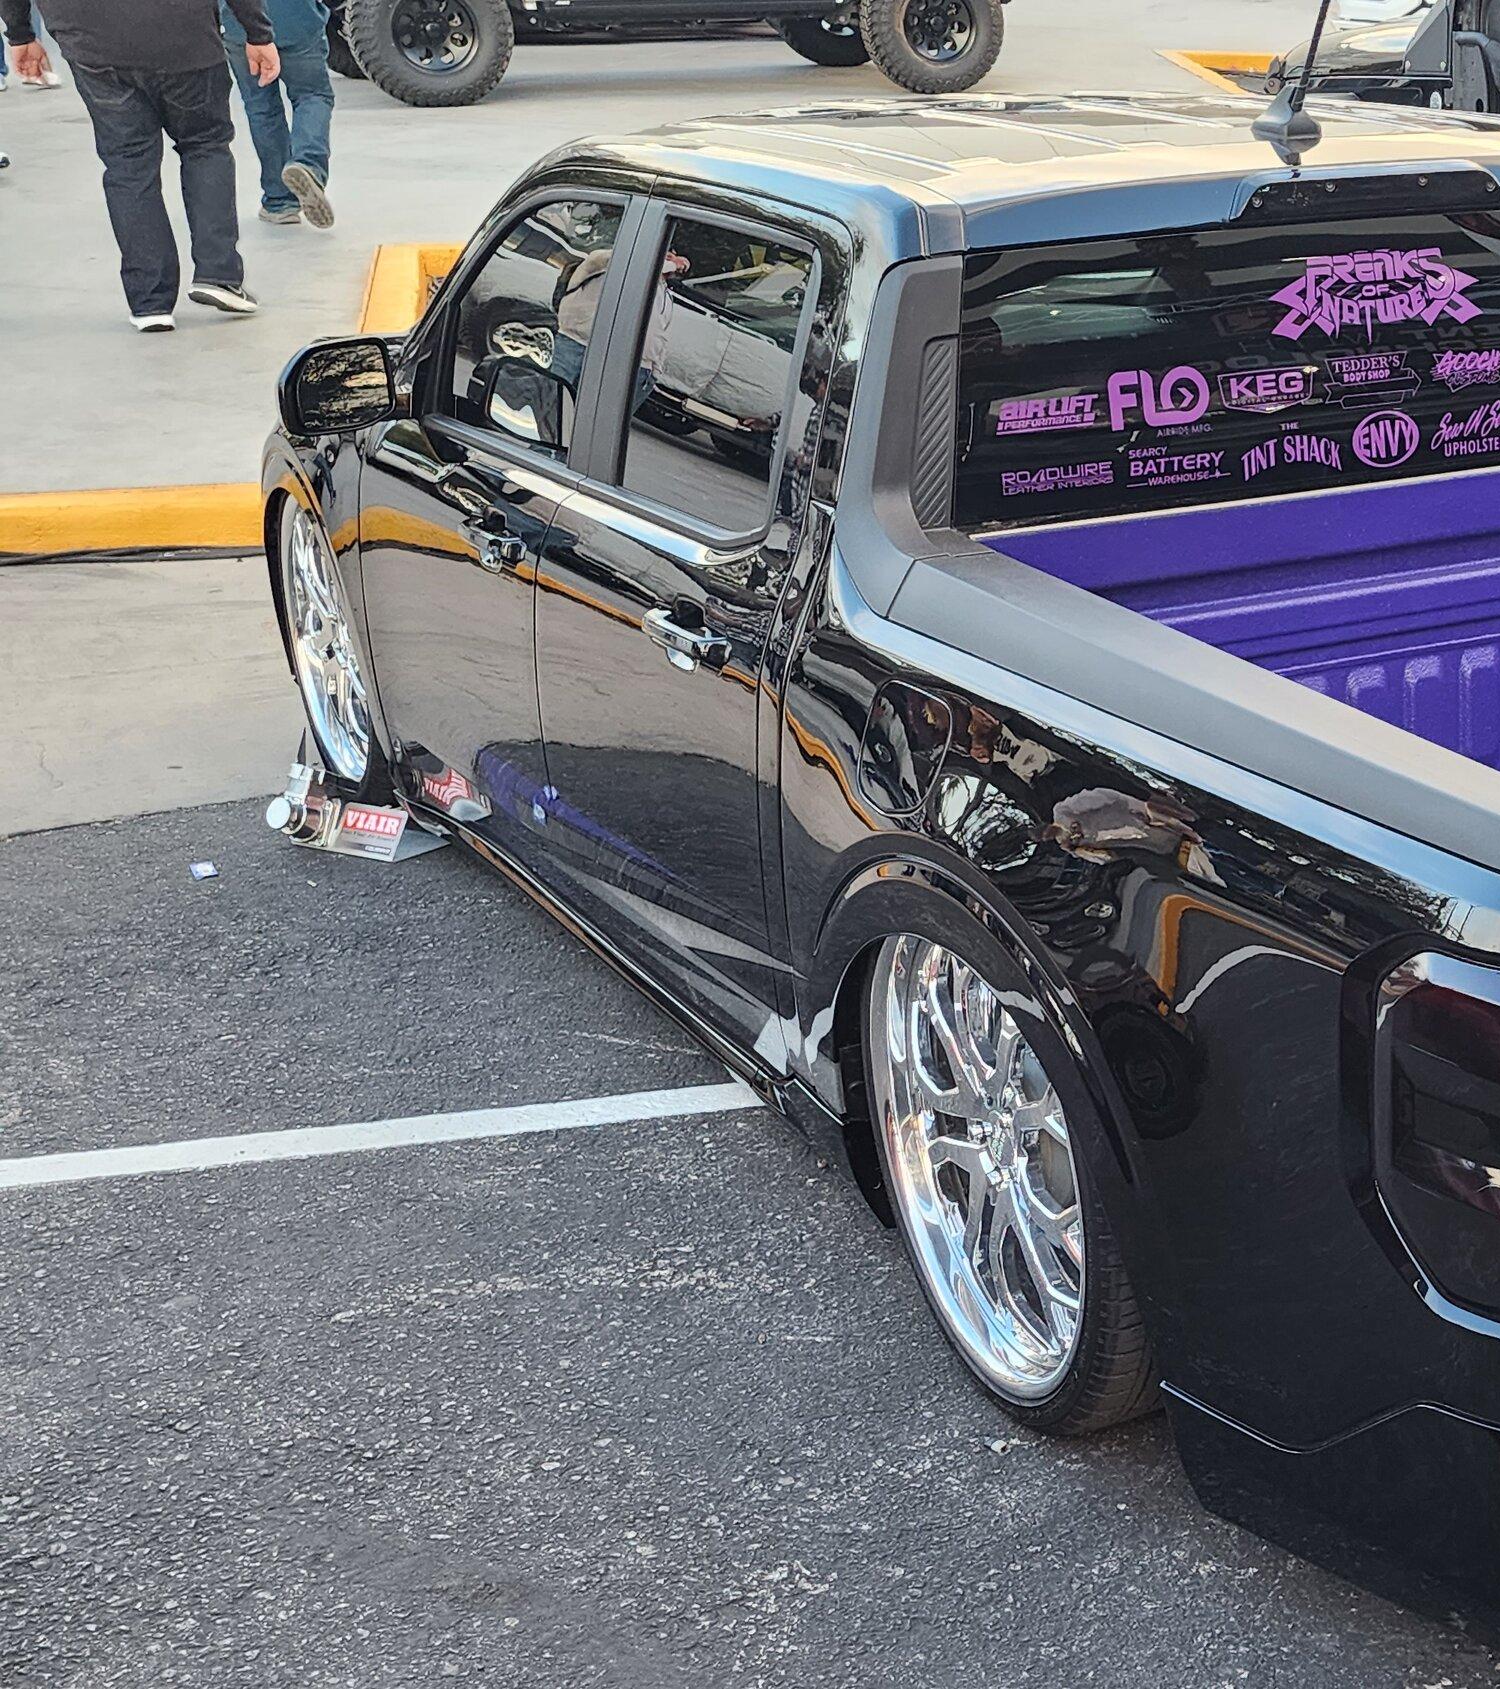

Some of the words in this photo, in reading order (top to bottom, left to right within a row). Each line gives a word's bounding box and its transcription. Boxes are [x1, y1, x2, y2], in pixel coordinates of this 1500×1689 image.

[1361, 283, 1391, 297] OF
[1319, 282, 1429, 341] NATURE
[1332, 355, 1401, 374] TEDDER'S
[1343, 372, 1367, 383] BODY
[1367, 368, 1391, 380] SHOP
[1229, 371, 1304, 399] KEG
[1047, 394, 1099, 417] LIFT
[1107, 365, 1211, 432] FLO
[1279, 421, 1300, 431] THE
[1359, 419, 1414, 459] ENVY
[1128, 446, 1168, 460] SEARCY
[1129, 450, 1225, 477] BATTERY
[1240, 438, 1278, 482] TINT
[1283, 434, 1343, 472] SHACK
[1001, 461, 1113, 485] ROADWIRE
[1147, 470, 1211, 487] WAREHOUSE
[346, 809, 401, 836] VIAIR
